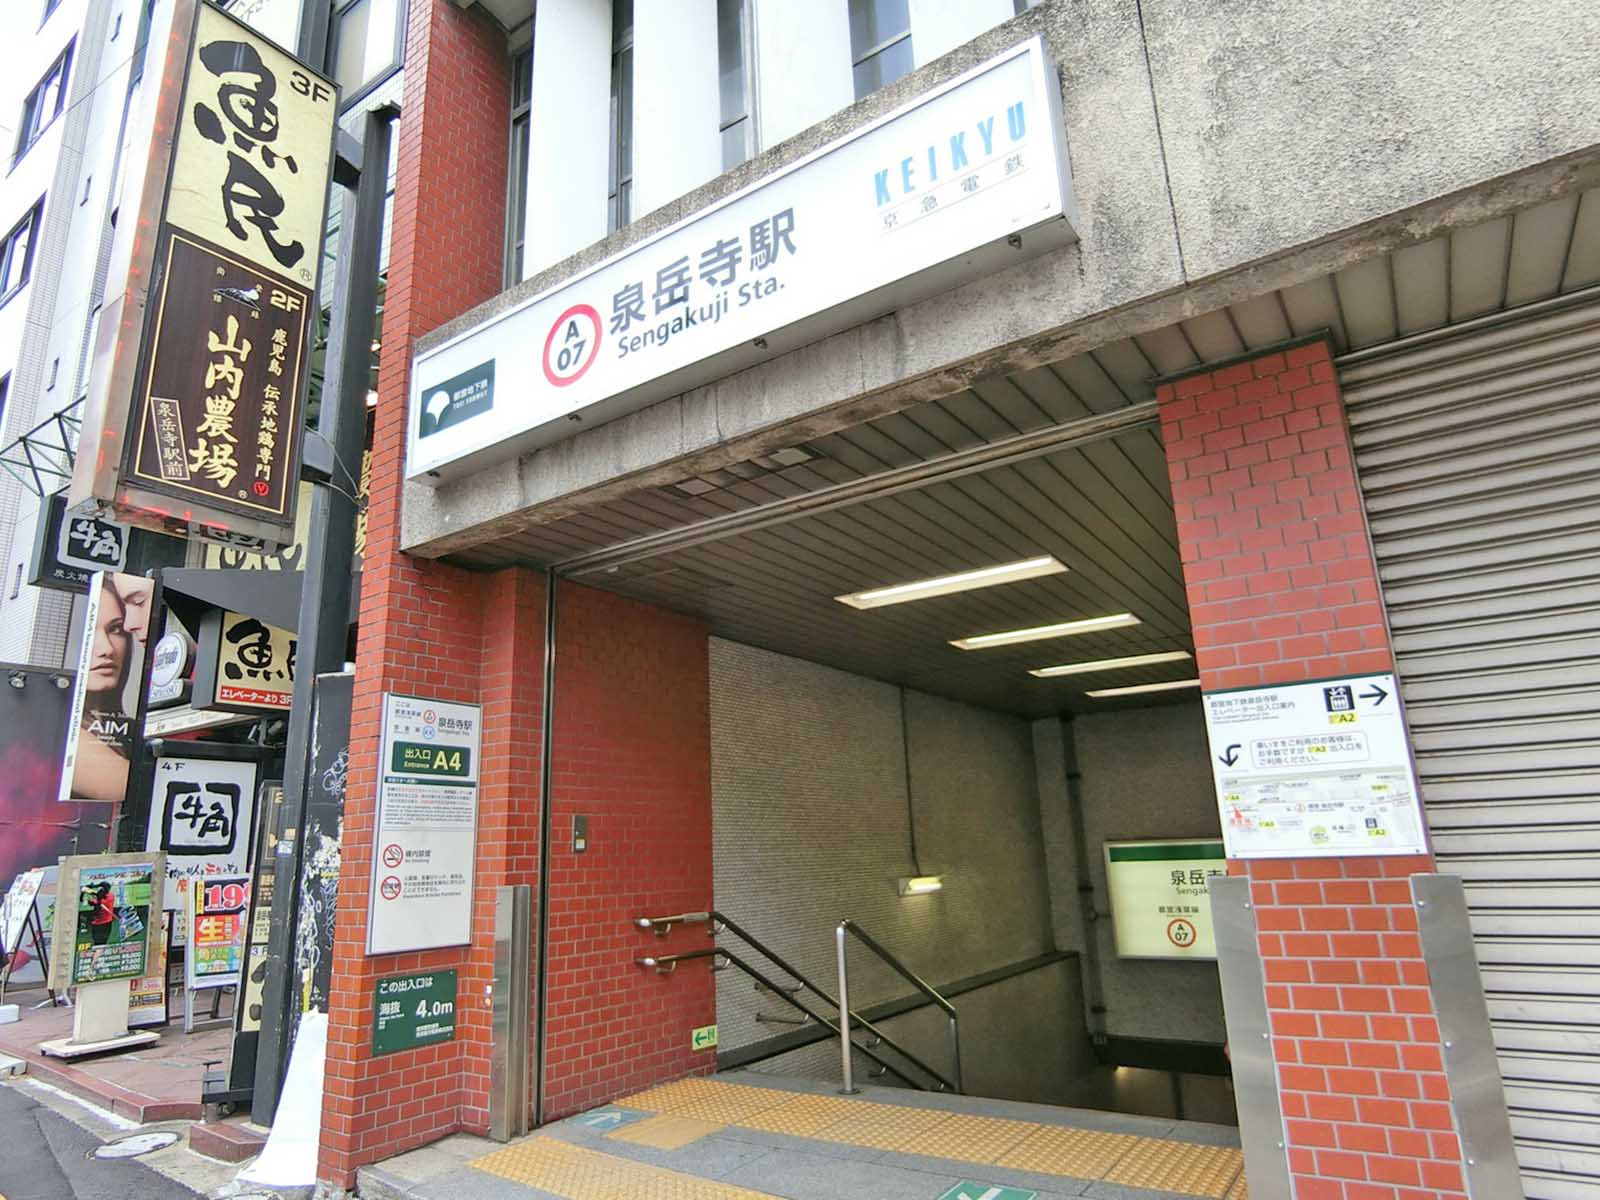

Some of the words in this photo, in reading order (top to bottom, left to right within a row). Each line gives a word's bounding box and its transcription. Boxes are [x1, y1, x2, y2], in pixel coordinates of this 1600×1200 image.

[289, 70, 331, 103] 3F
[193, 40, 305, 269] 魚民
[874, 101, 1026, 208] KEIKYU
[884, 154, 1024, 229] 京急電鉄
[609, 207, 797, 335] 泉岳寺駅
[270, 289, 301, 313] 2F
[618, 292, 729, 359] Sengakuji
[738, 276, 785, 307] Sta.
[565, 320, 580, 344] A
[557, 340, 586, 372] 07
[188, 314, 252, 488] 山内農場
[157, 402, 185, 478] 泉岳寺駅前
[70, 520, 120, 561] 牛角
[87, 720, 130, 736] AIM
[403, 760, 430, 769] Entrance
[404, 747, 432, 760] 出入口
[433, 750, 461, 771] A4
[174, 795, 230, 838] 牛角
[199, 916, 225, 941] 生
[1174, 932, 1188, 942] 07
[1177, 923, 1186, 931] A
[380, 976, 433, 994] この出入口は
[416, 1000, 453, 1018] 4.0m
